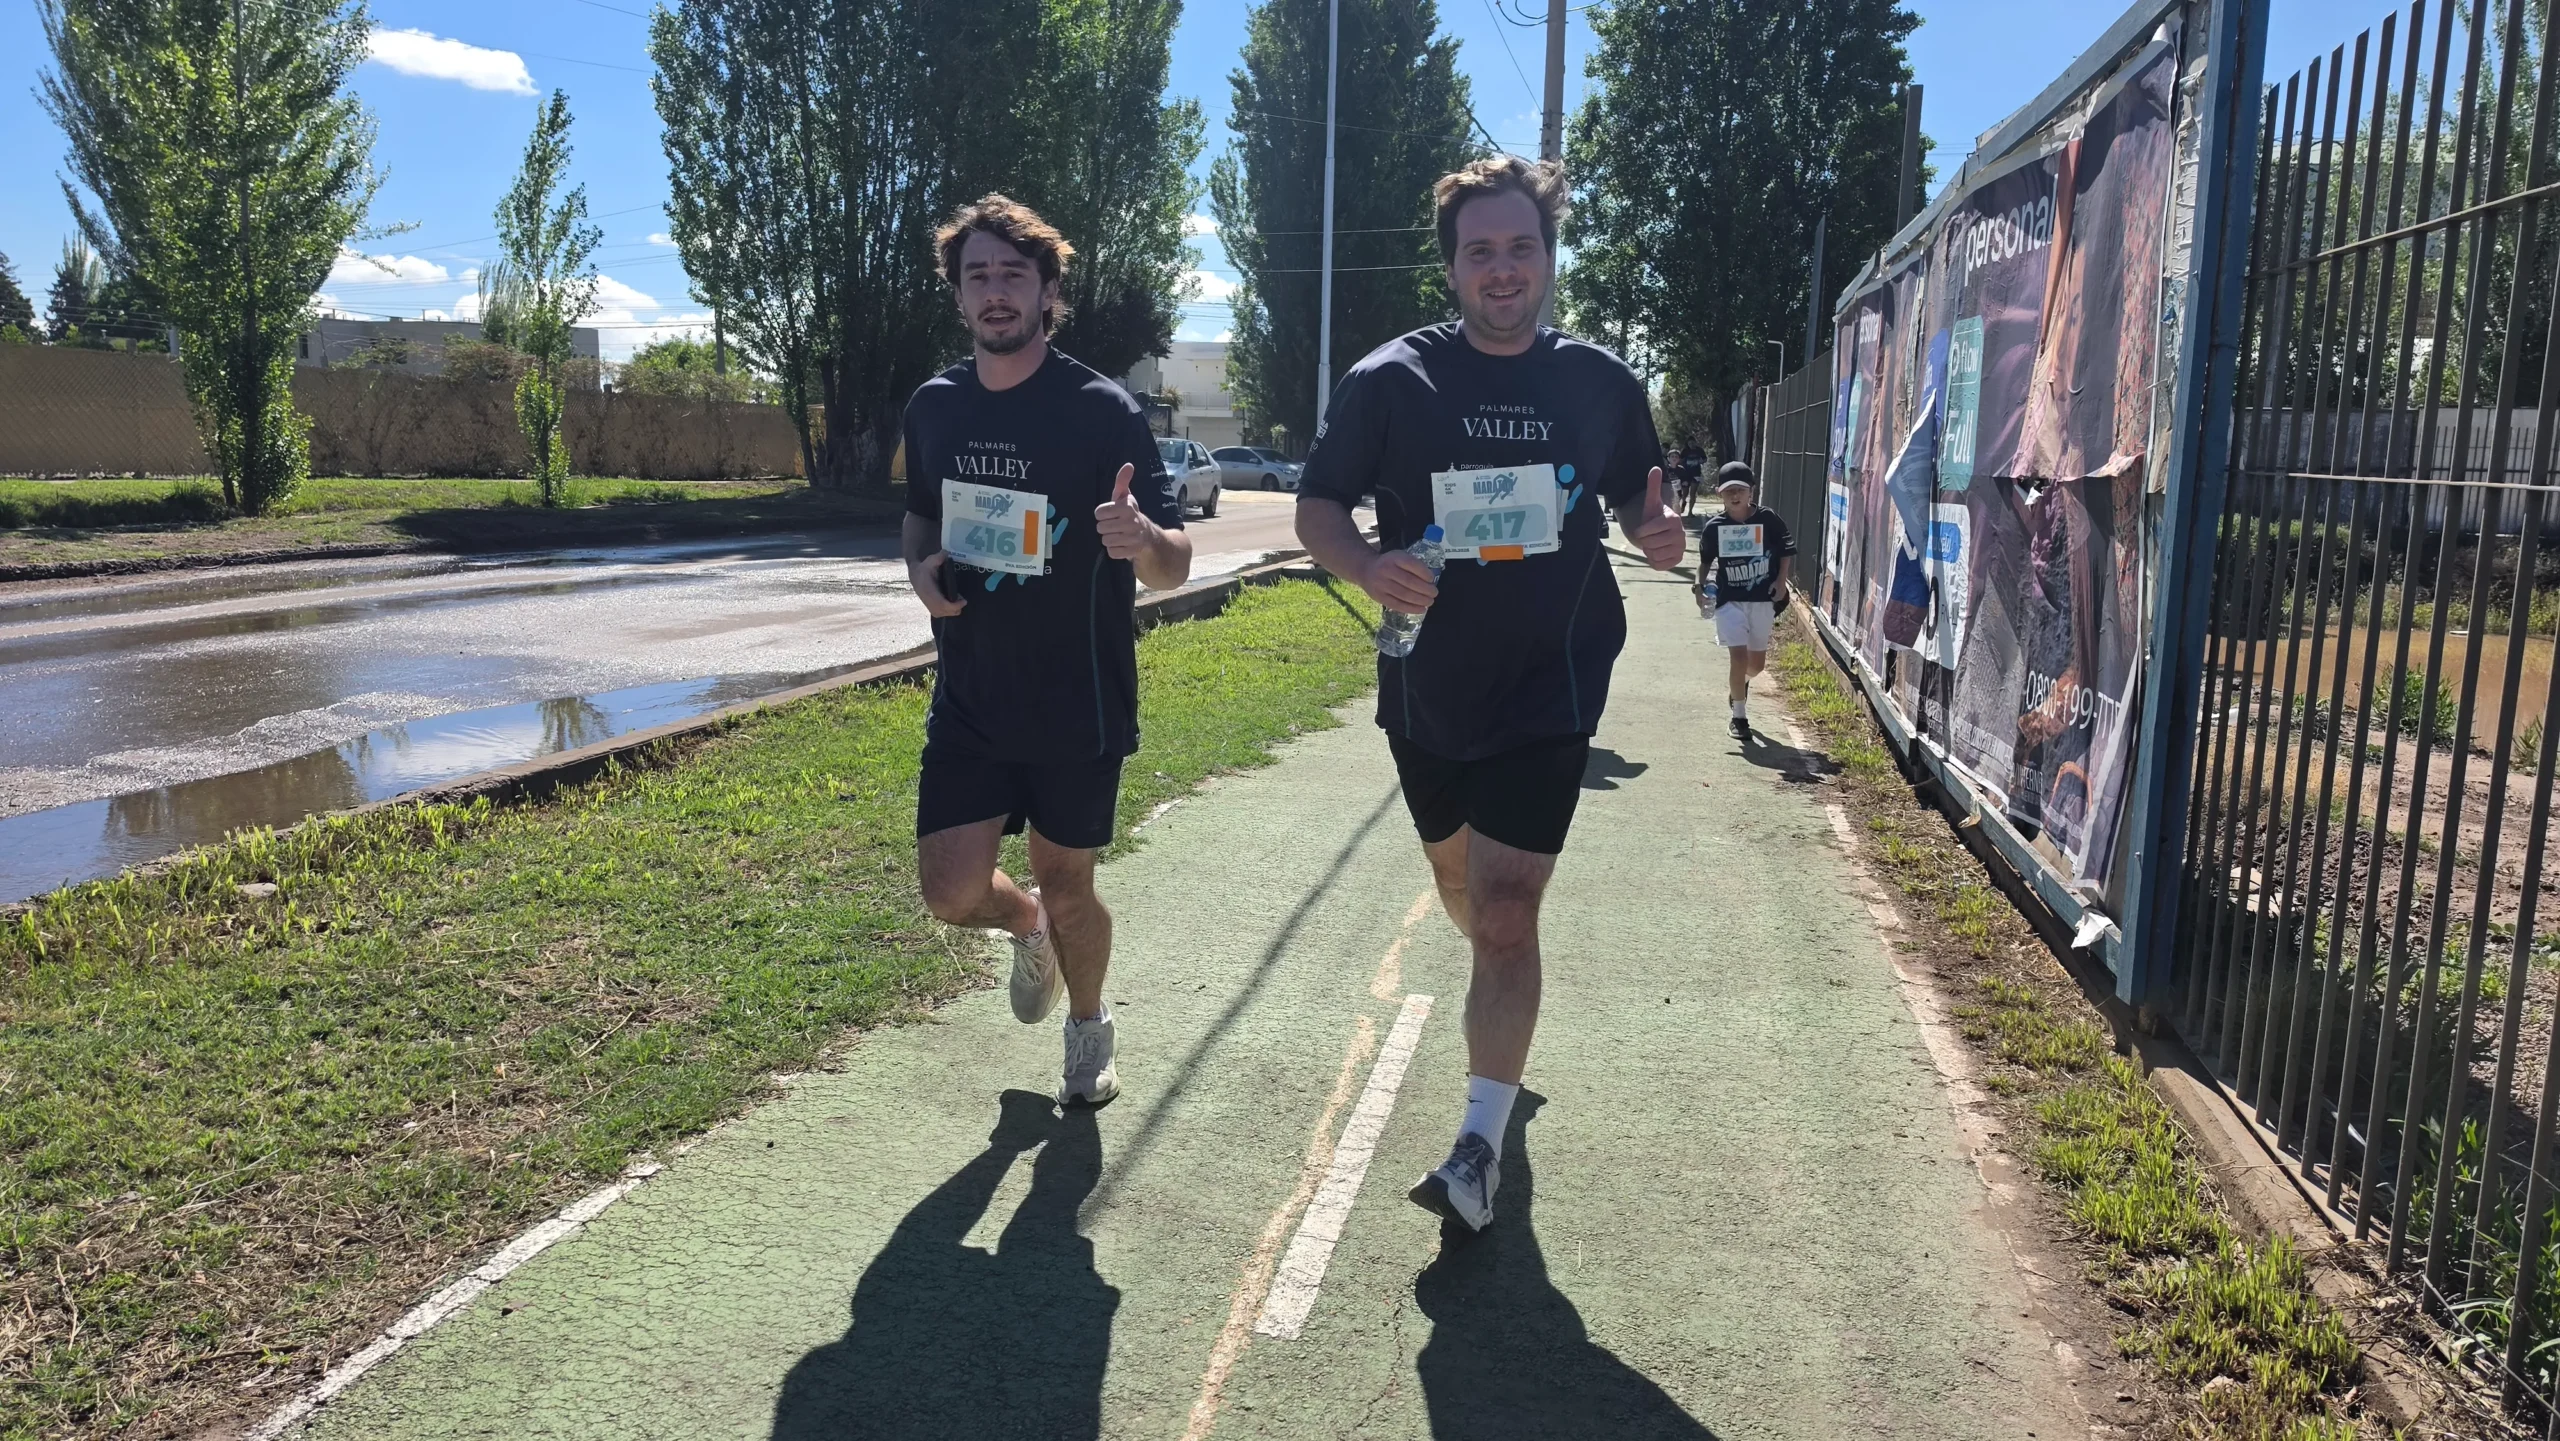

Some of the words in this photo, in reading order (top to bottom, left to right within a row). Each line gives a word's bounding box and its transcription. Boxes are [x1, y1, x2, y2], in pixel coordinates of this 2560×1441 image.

[1964, 173, 2058, 287] personal
[1961, 340, 1979, 373] flow
[1479, 405, 1535, 415] PALMARES
[1462, 418, 1554, 441] VALLEY
[968, 441, 1017, 452] PALMARES
[954, 455, 1033, 480] VALLEY
[1465, 511, 1526, 541] 417
[965, 525, 1017, 557] 416
[1728, 540, 1753, 551] 330
